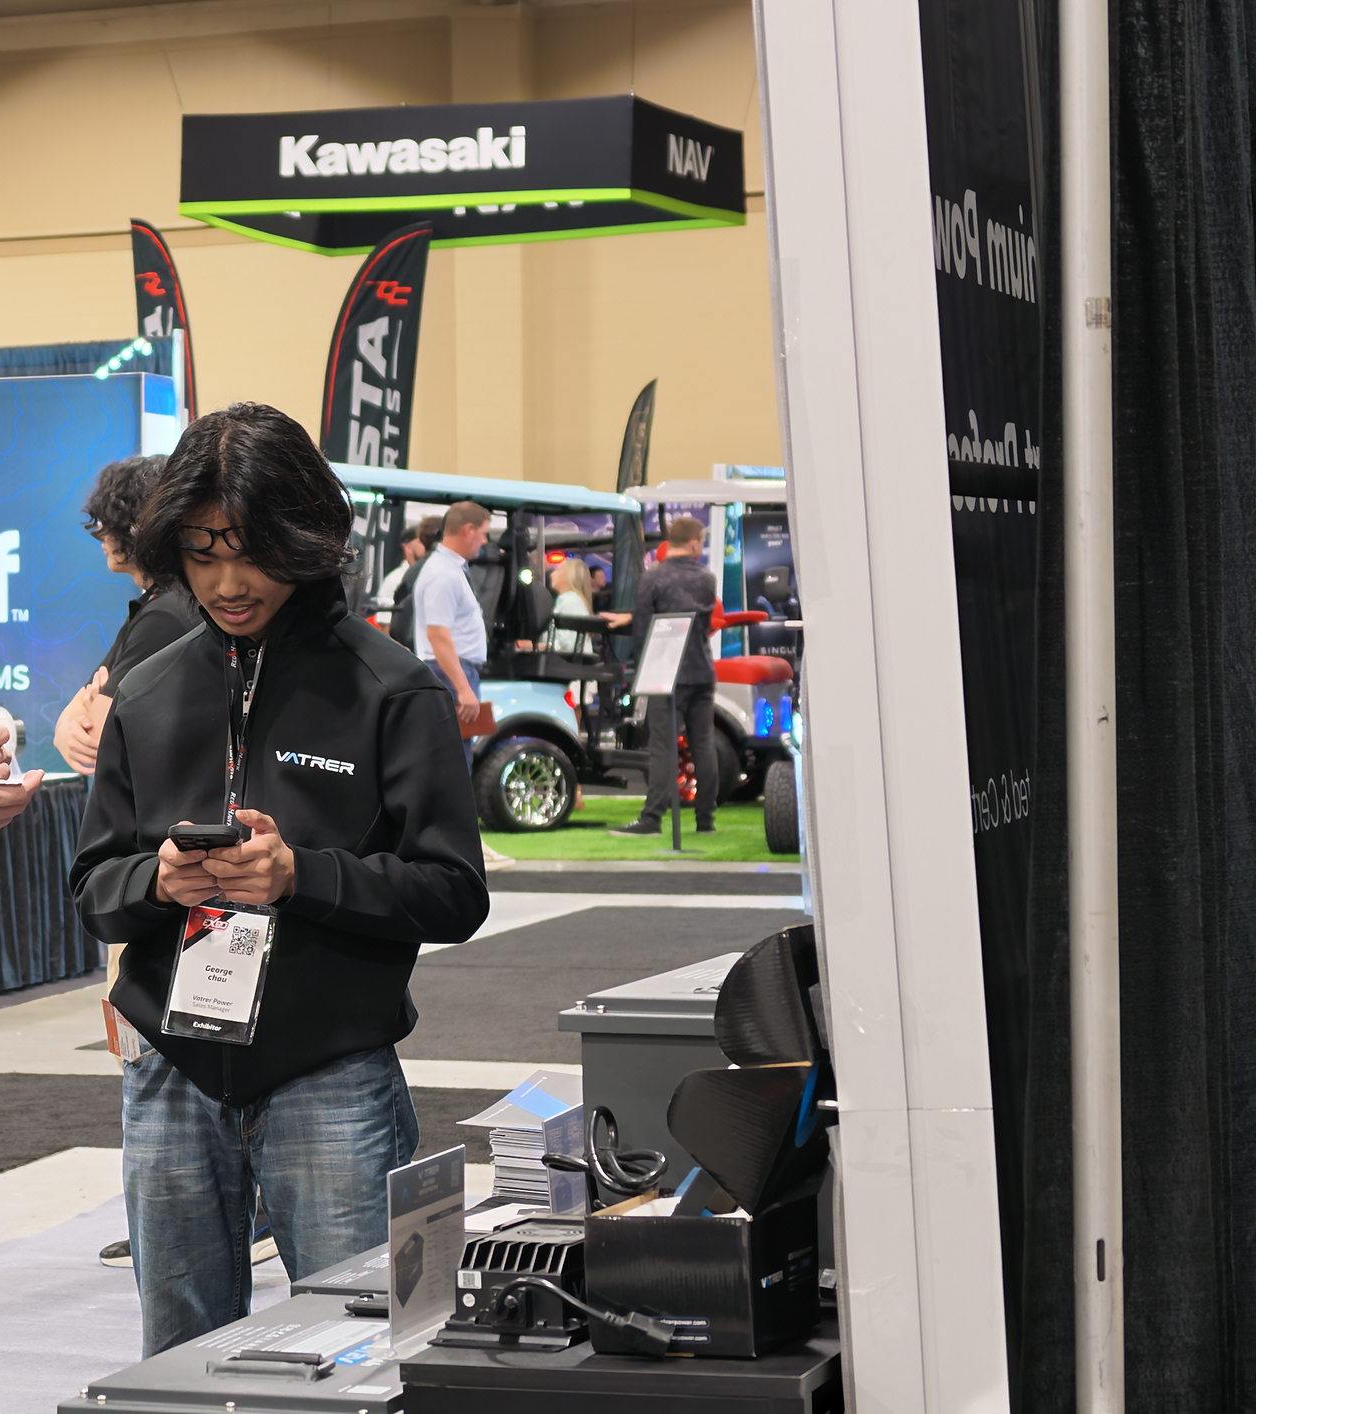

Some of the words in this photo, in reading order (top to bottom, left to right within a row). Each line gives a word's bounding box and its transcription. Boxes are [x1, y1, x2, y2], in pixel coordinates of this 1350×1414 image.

[280, 126, 526, 177] Kawasaki
[667, 132, 713, 182] NAV
[275, 750, 355, 776] VATRER
[205, 965, 233, 976] George
[208, 974, 227, 983] chau
[213, 997, 234, 1007] Power
[208, 1003, 231, 1013] Manager
[193, 1021, 222, 1031] Exhibitor
